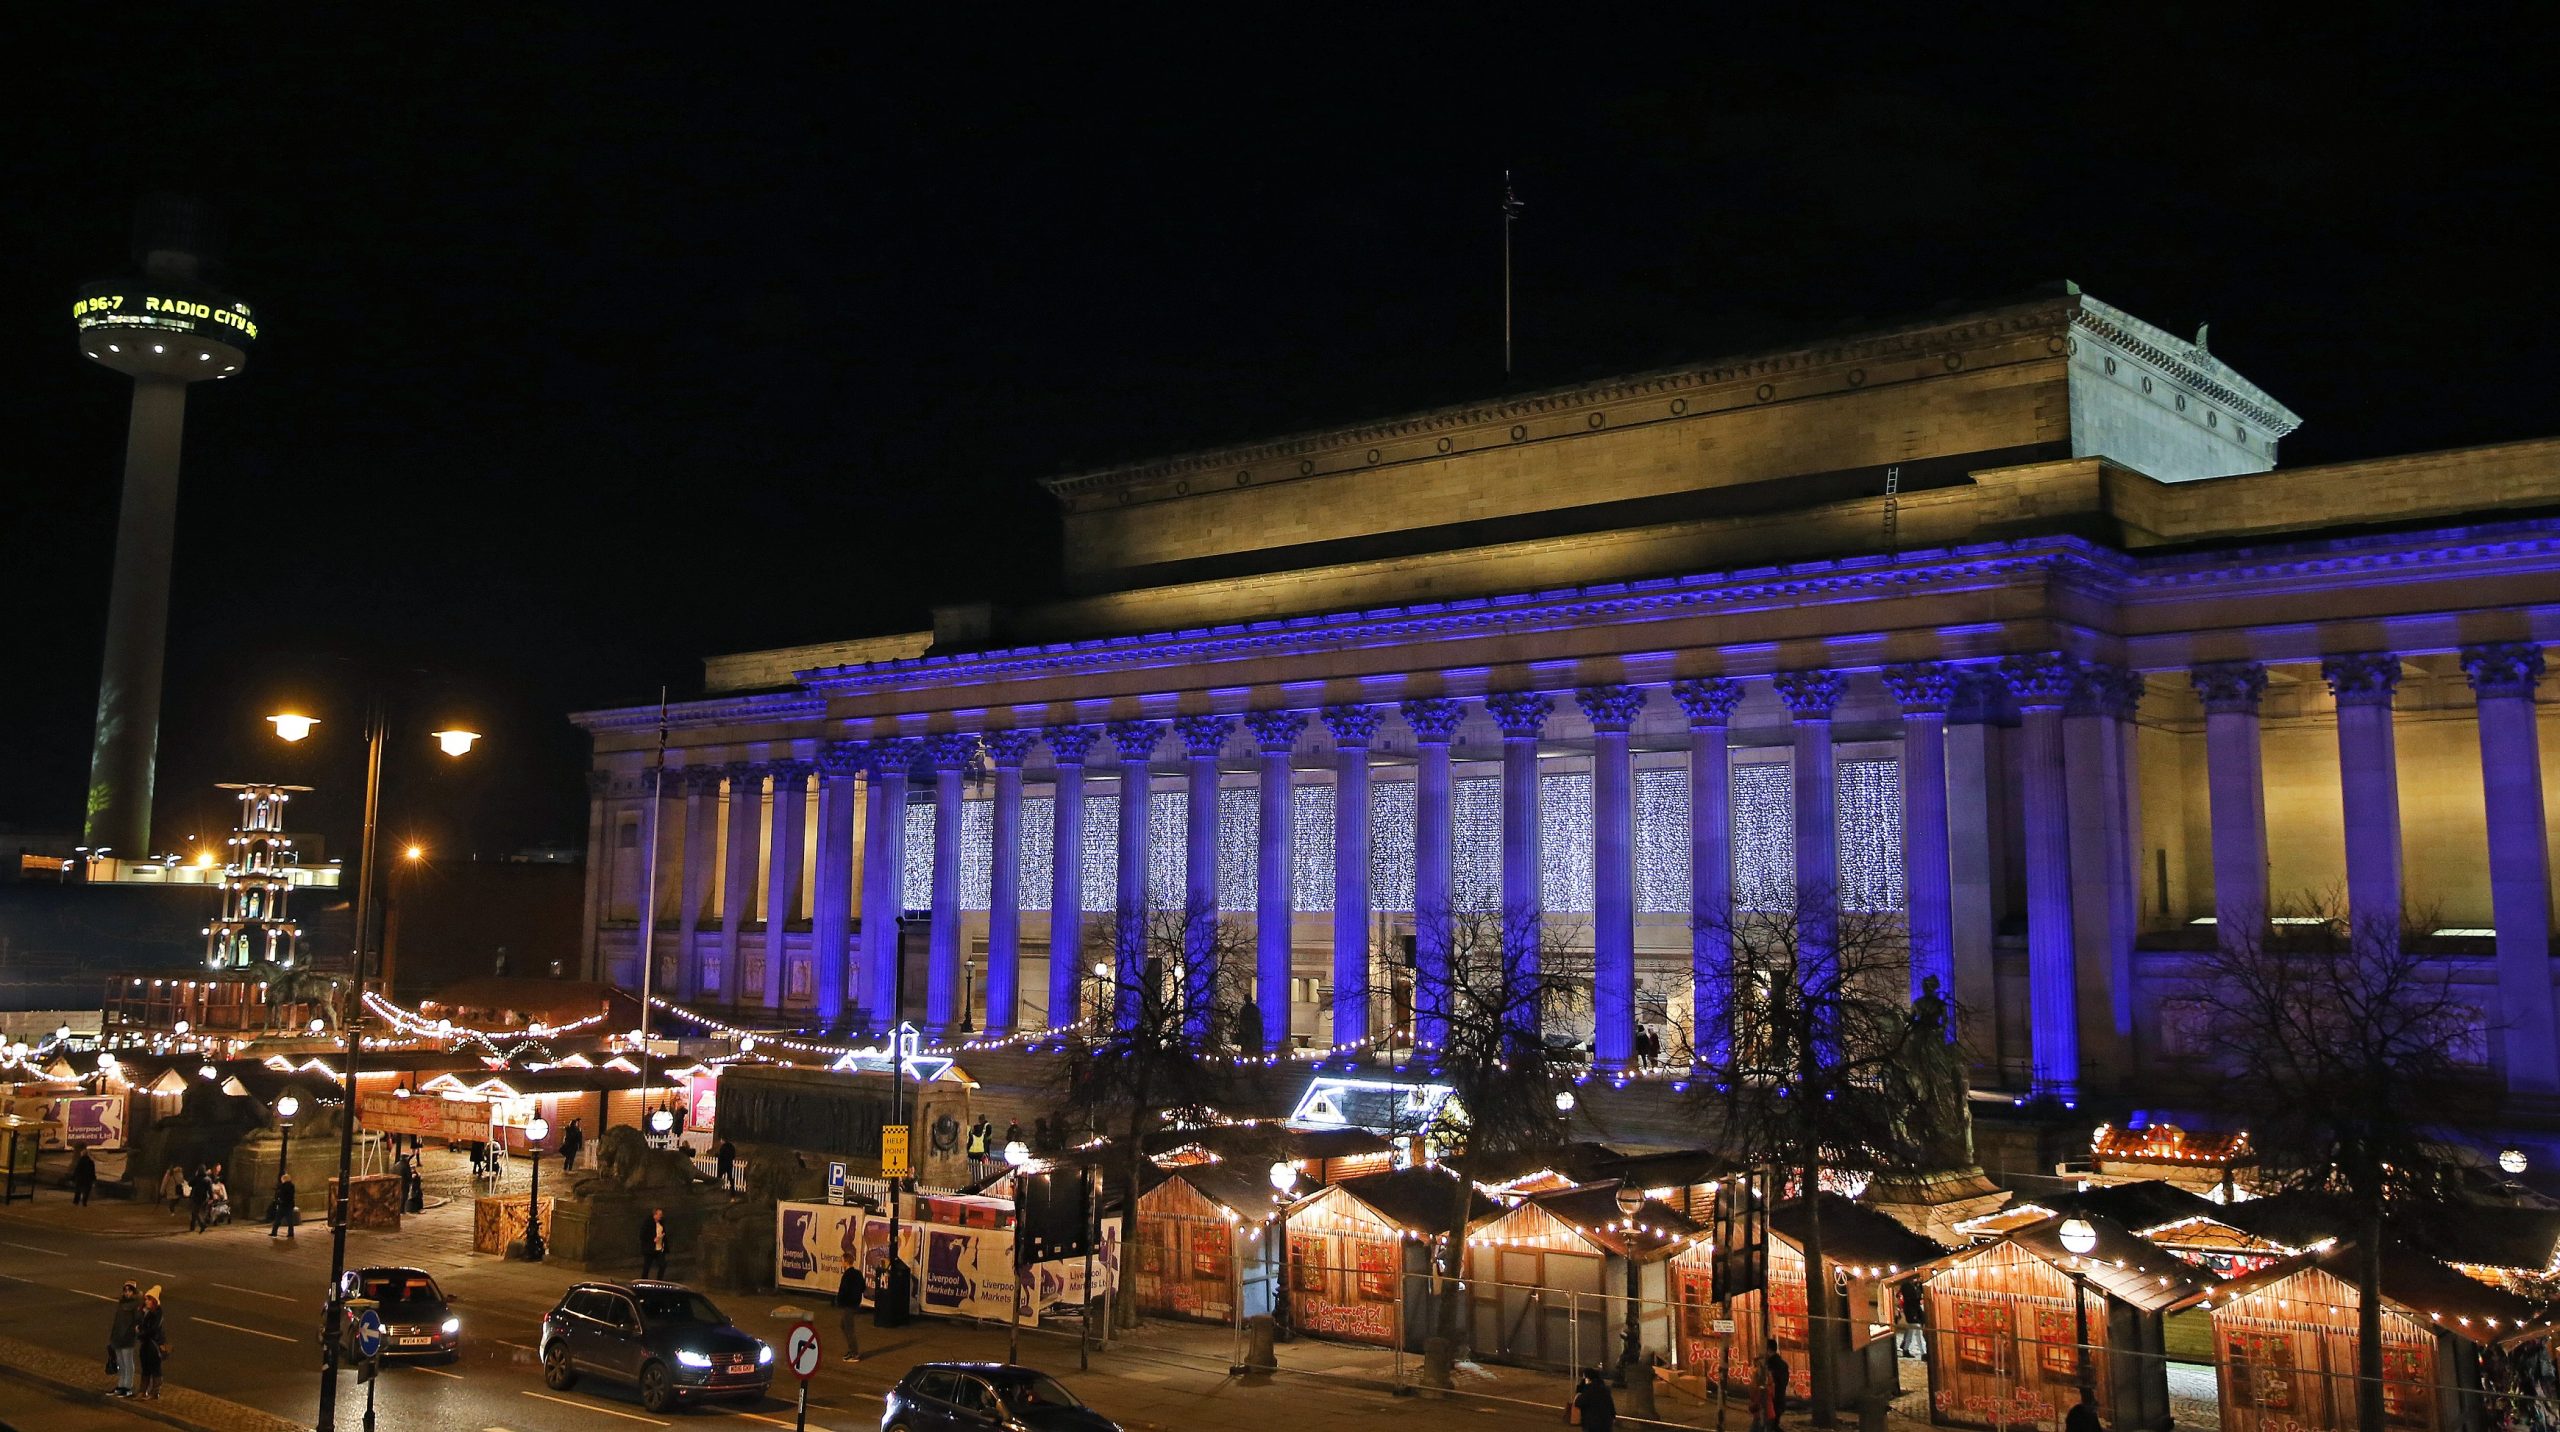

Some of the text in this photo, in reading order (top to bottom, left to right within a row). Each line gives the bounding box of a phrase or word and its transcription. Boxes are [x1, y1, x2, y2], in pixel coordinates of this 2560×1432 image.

[146, 297, 210, 318] RADIO
[214, 309, 246, 330] CITY
[68, 1126, 103, 1134] Liverpool
[832, 1165, 844, 1185] P
[783, 1247, 804, 1259] Liverpool
[783, 1259, 811, 1270] Markets Ltd
[821, 1264, 839, 1274] Markets
[928, 1273, 960, 1285] Liverpool
[1070, 1270, 1101, 1280] Liveool
[927, 1284, 968, 1297] Markets Ltd
[982, 1280, 1014, 1291] Liverpoo
[1042, 1285, 1055, 1295] Ltd
[1069, 1281, 1097, 1291] Marts
[981, 1291, 1012, 1303] Markets
